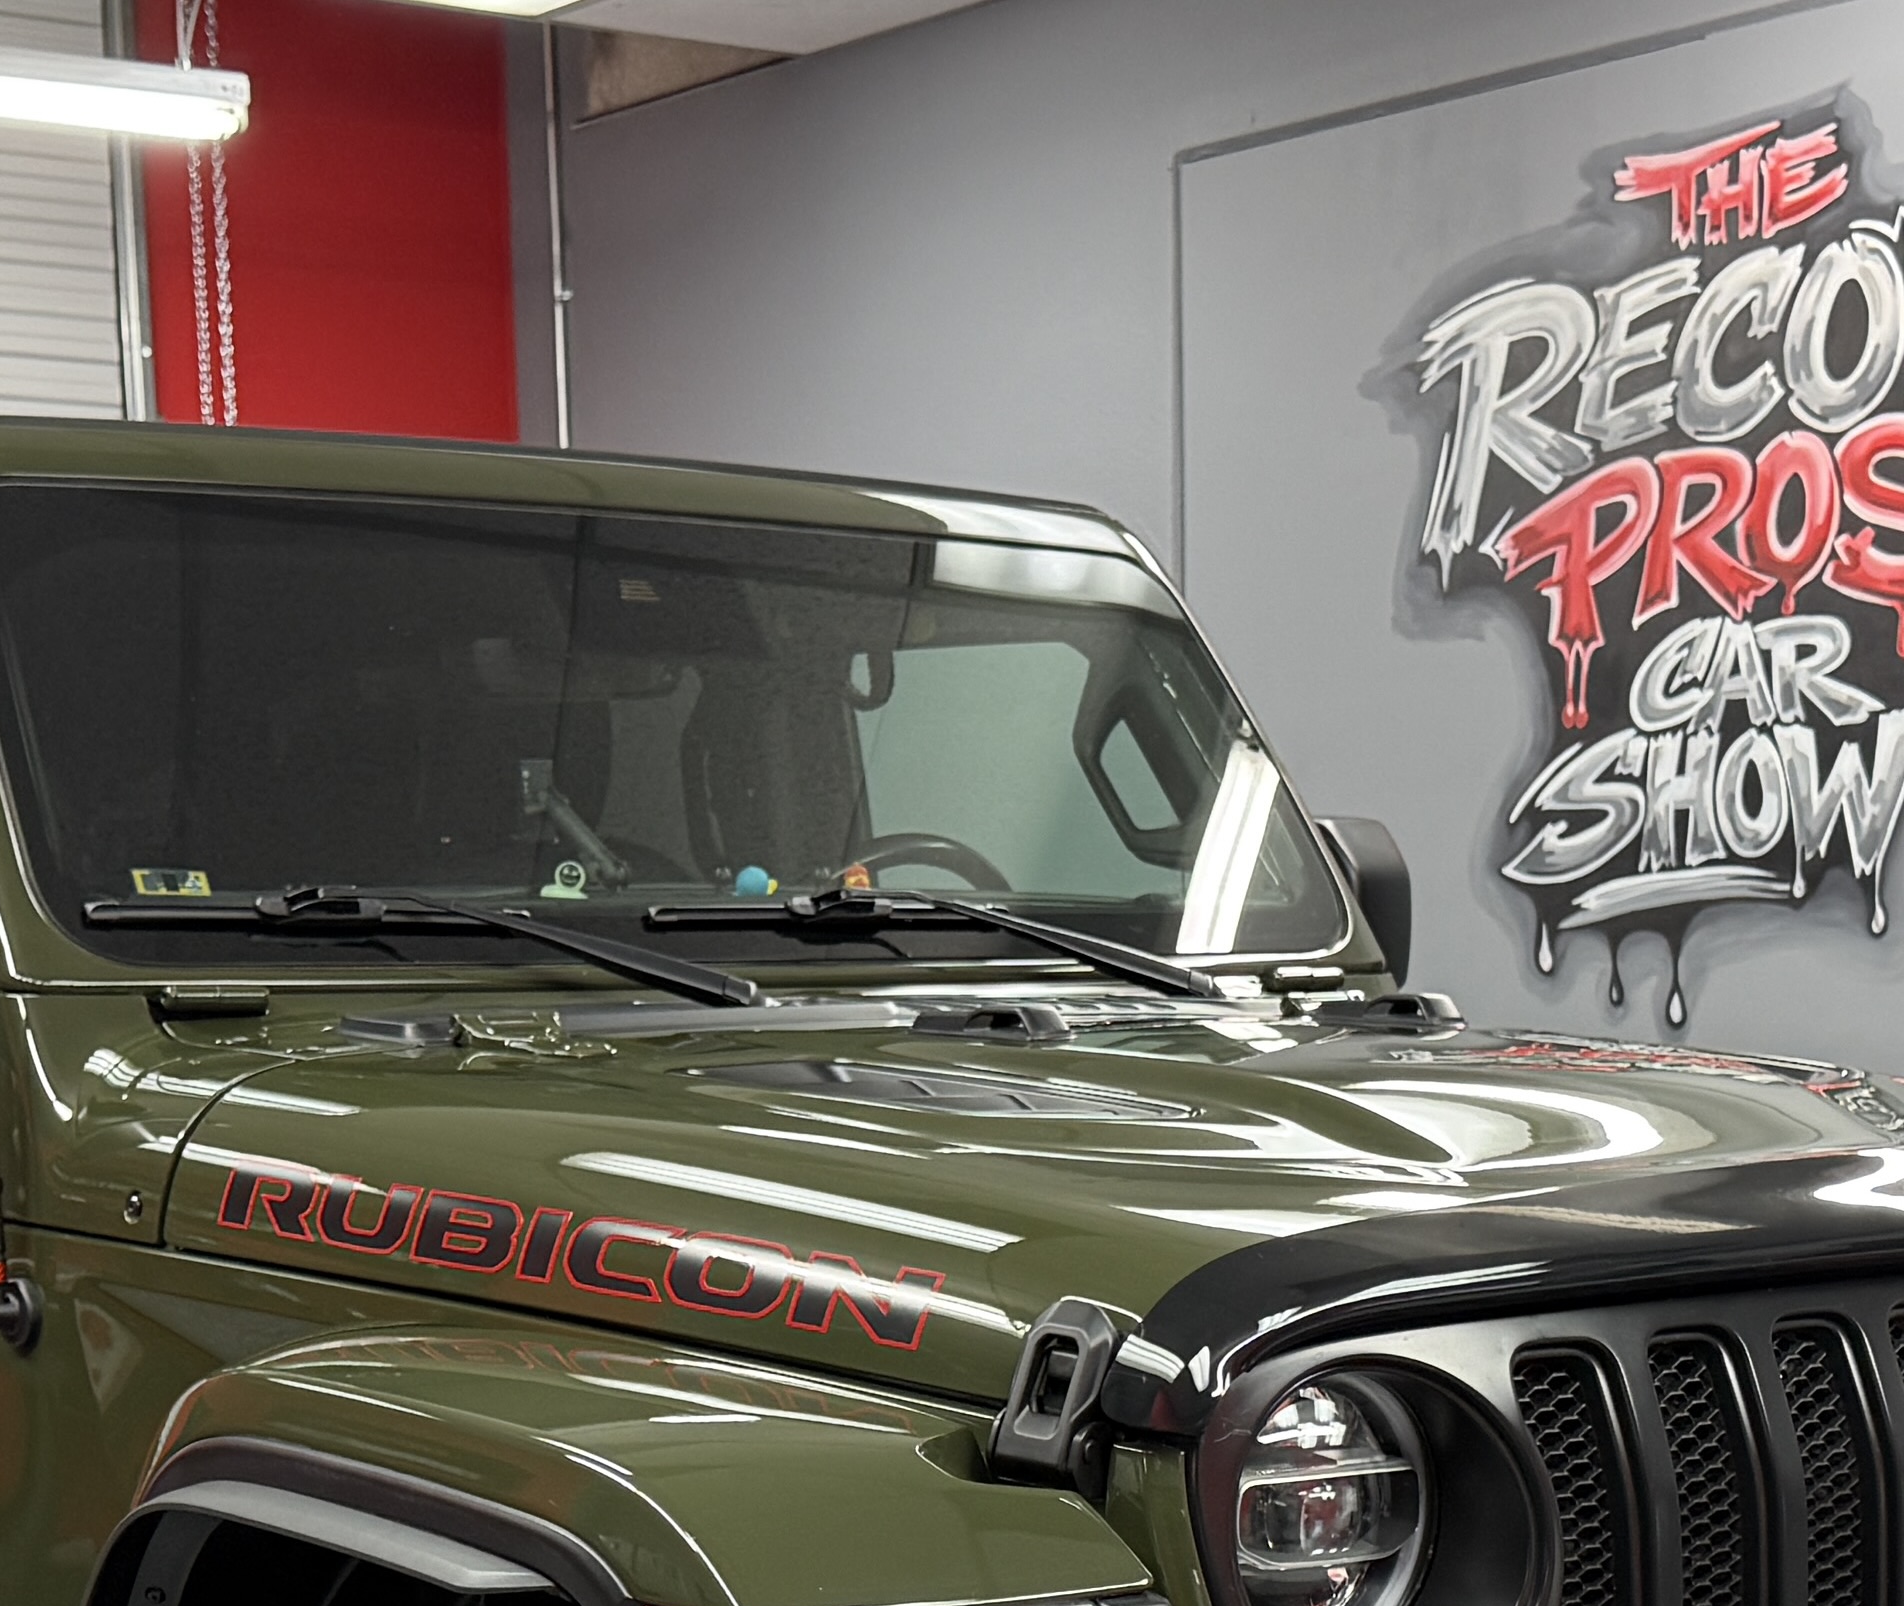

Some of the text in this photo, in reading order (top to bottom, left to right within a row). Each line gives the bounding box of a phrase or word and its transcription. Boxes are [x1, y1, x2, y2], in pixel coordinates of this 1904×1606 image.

[1614, 120, 1848, 247] THE
[1628, 614, 1884, 734] CAR
[217, 1162, 946, 1351] RUBICON
